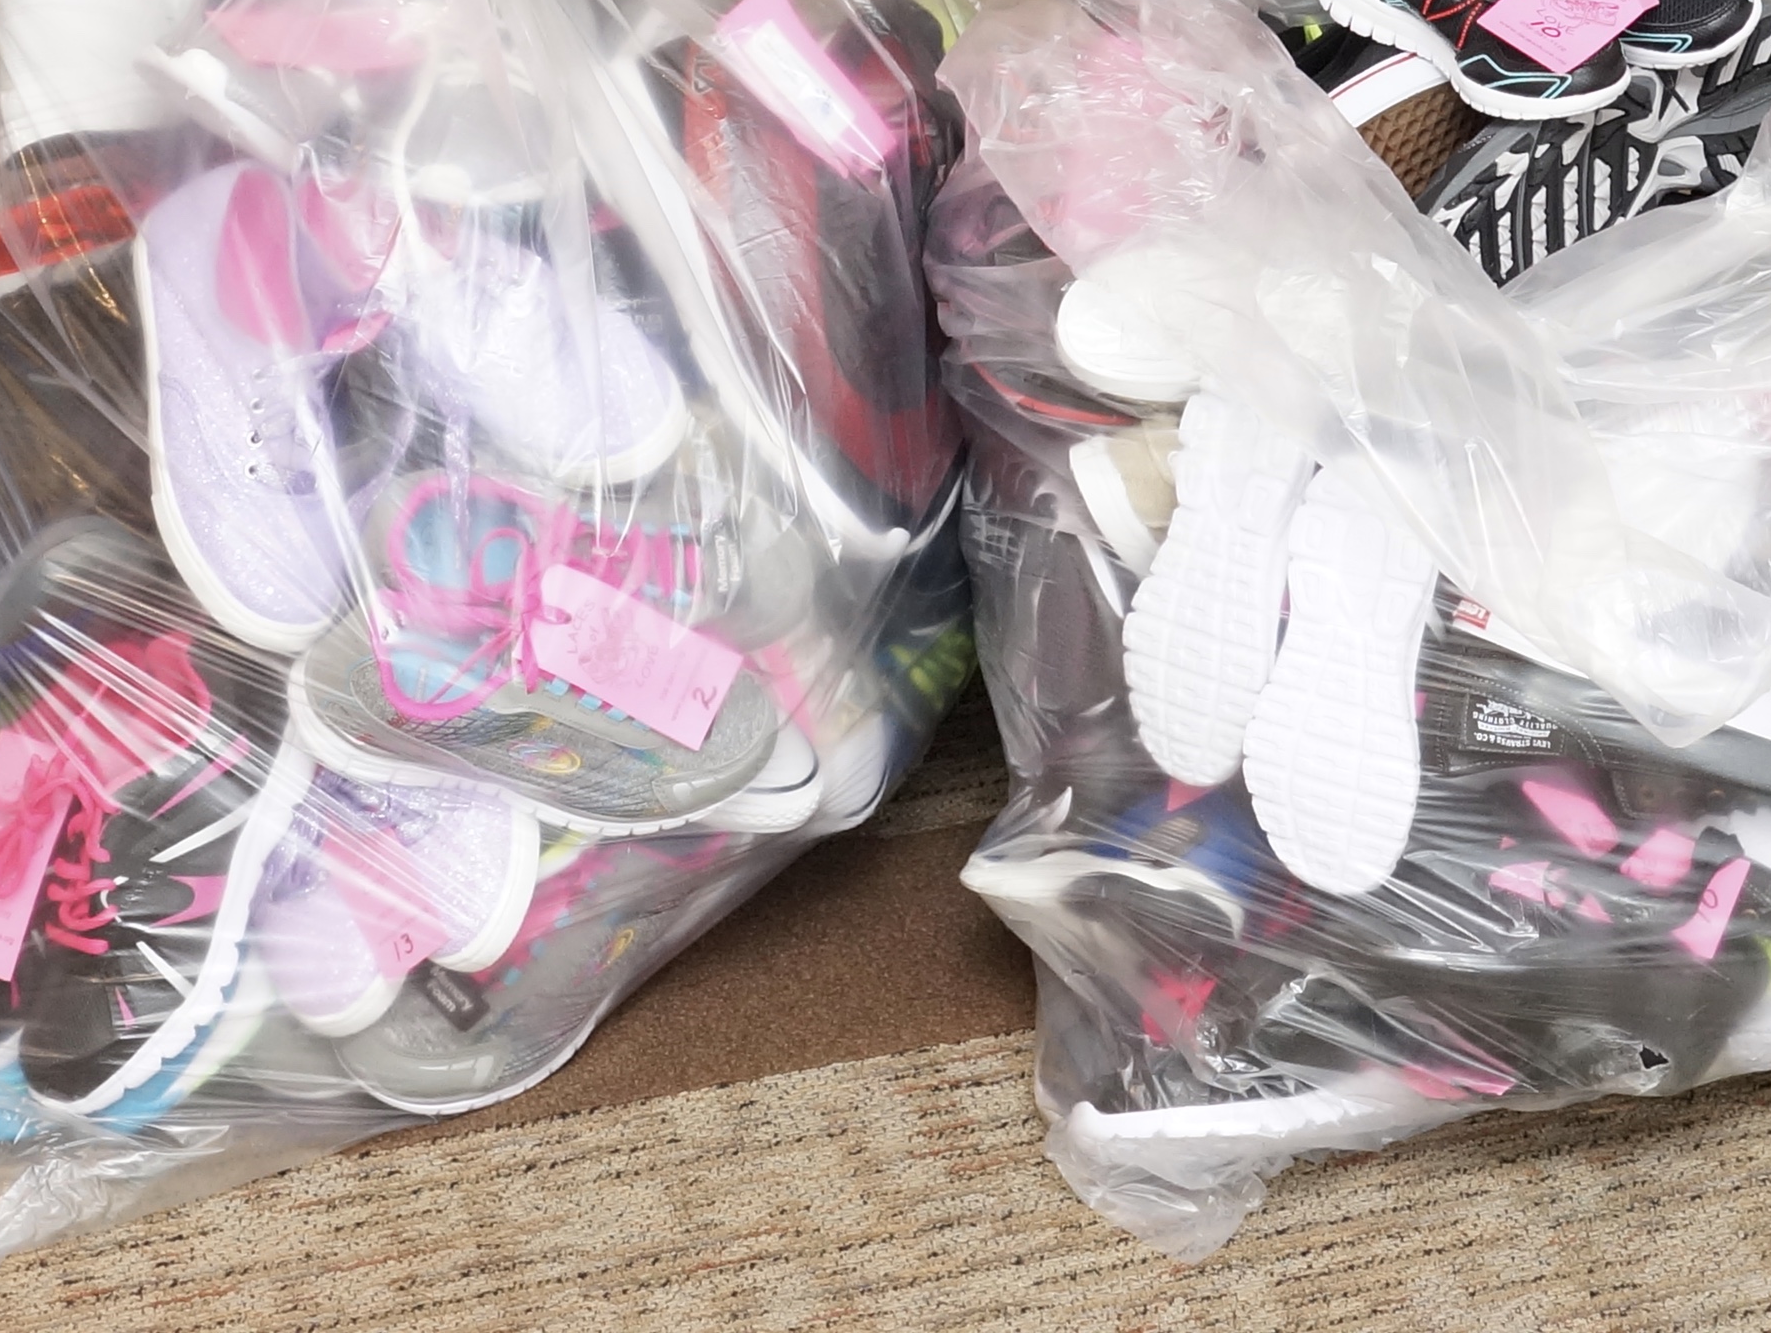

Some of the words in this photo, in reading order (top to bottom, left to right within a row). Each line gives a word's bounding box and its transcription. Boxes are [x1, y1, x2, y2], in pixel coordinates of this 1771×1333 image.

[1530, 20, 1562, 39] 10
[1536, 7, 1576, 37] LOVE
[566, 599, 597, 655] LACES
[691, 685, 718, 711] 2
[1472, 710, 1517, 725] CLOTHING
[1496, 734, 1531, 748] STRAUSS
[393, 933, 415, 963] 13
